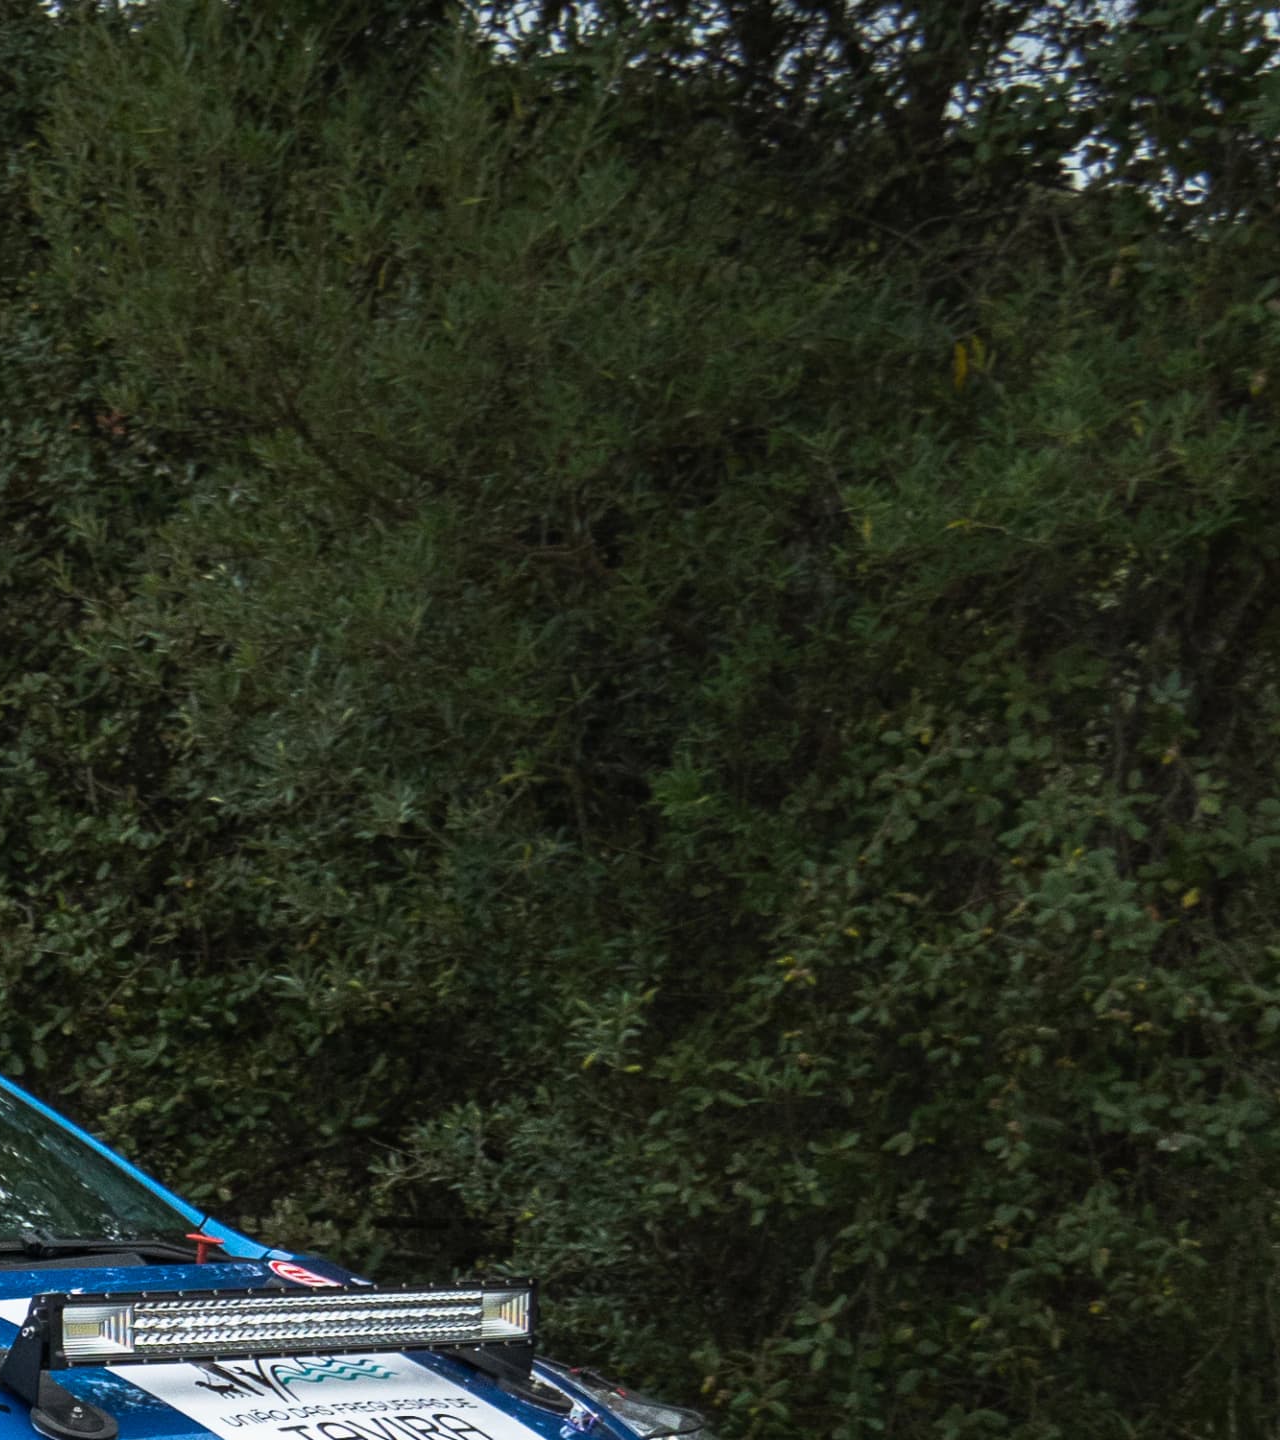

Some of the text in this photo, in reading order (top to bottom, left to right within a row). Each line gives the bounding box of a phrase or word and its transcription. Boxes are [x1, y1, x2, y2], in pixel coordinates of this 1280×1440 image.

[220, 1408, 289, 1428] UNIÃO
[290, 1404, 336, 1420] DAS
[445, 1397, 479, 1409] DE
